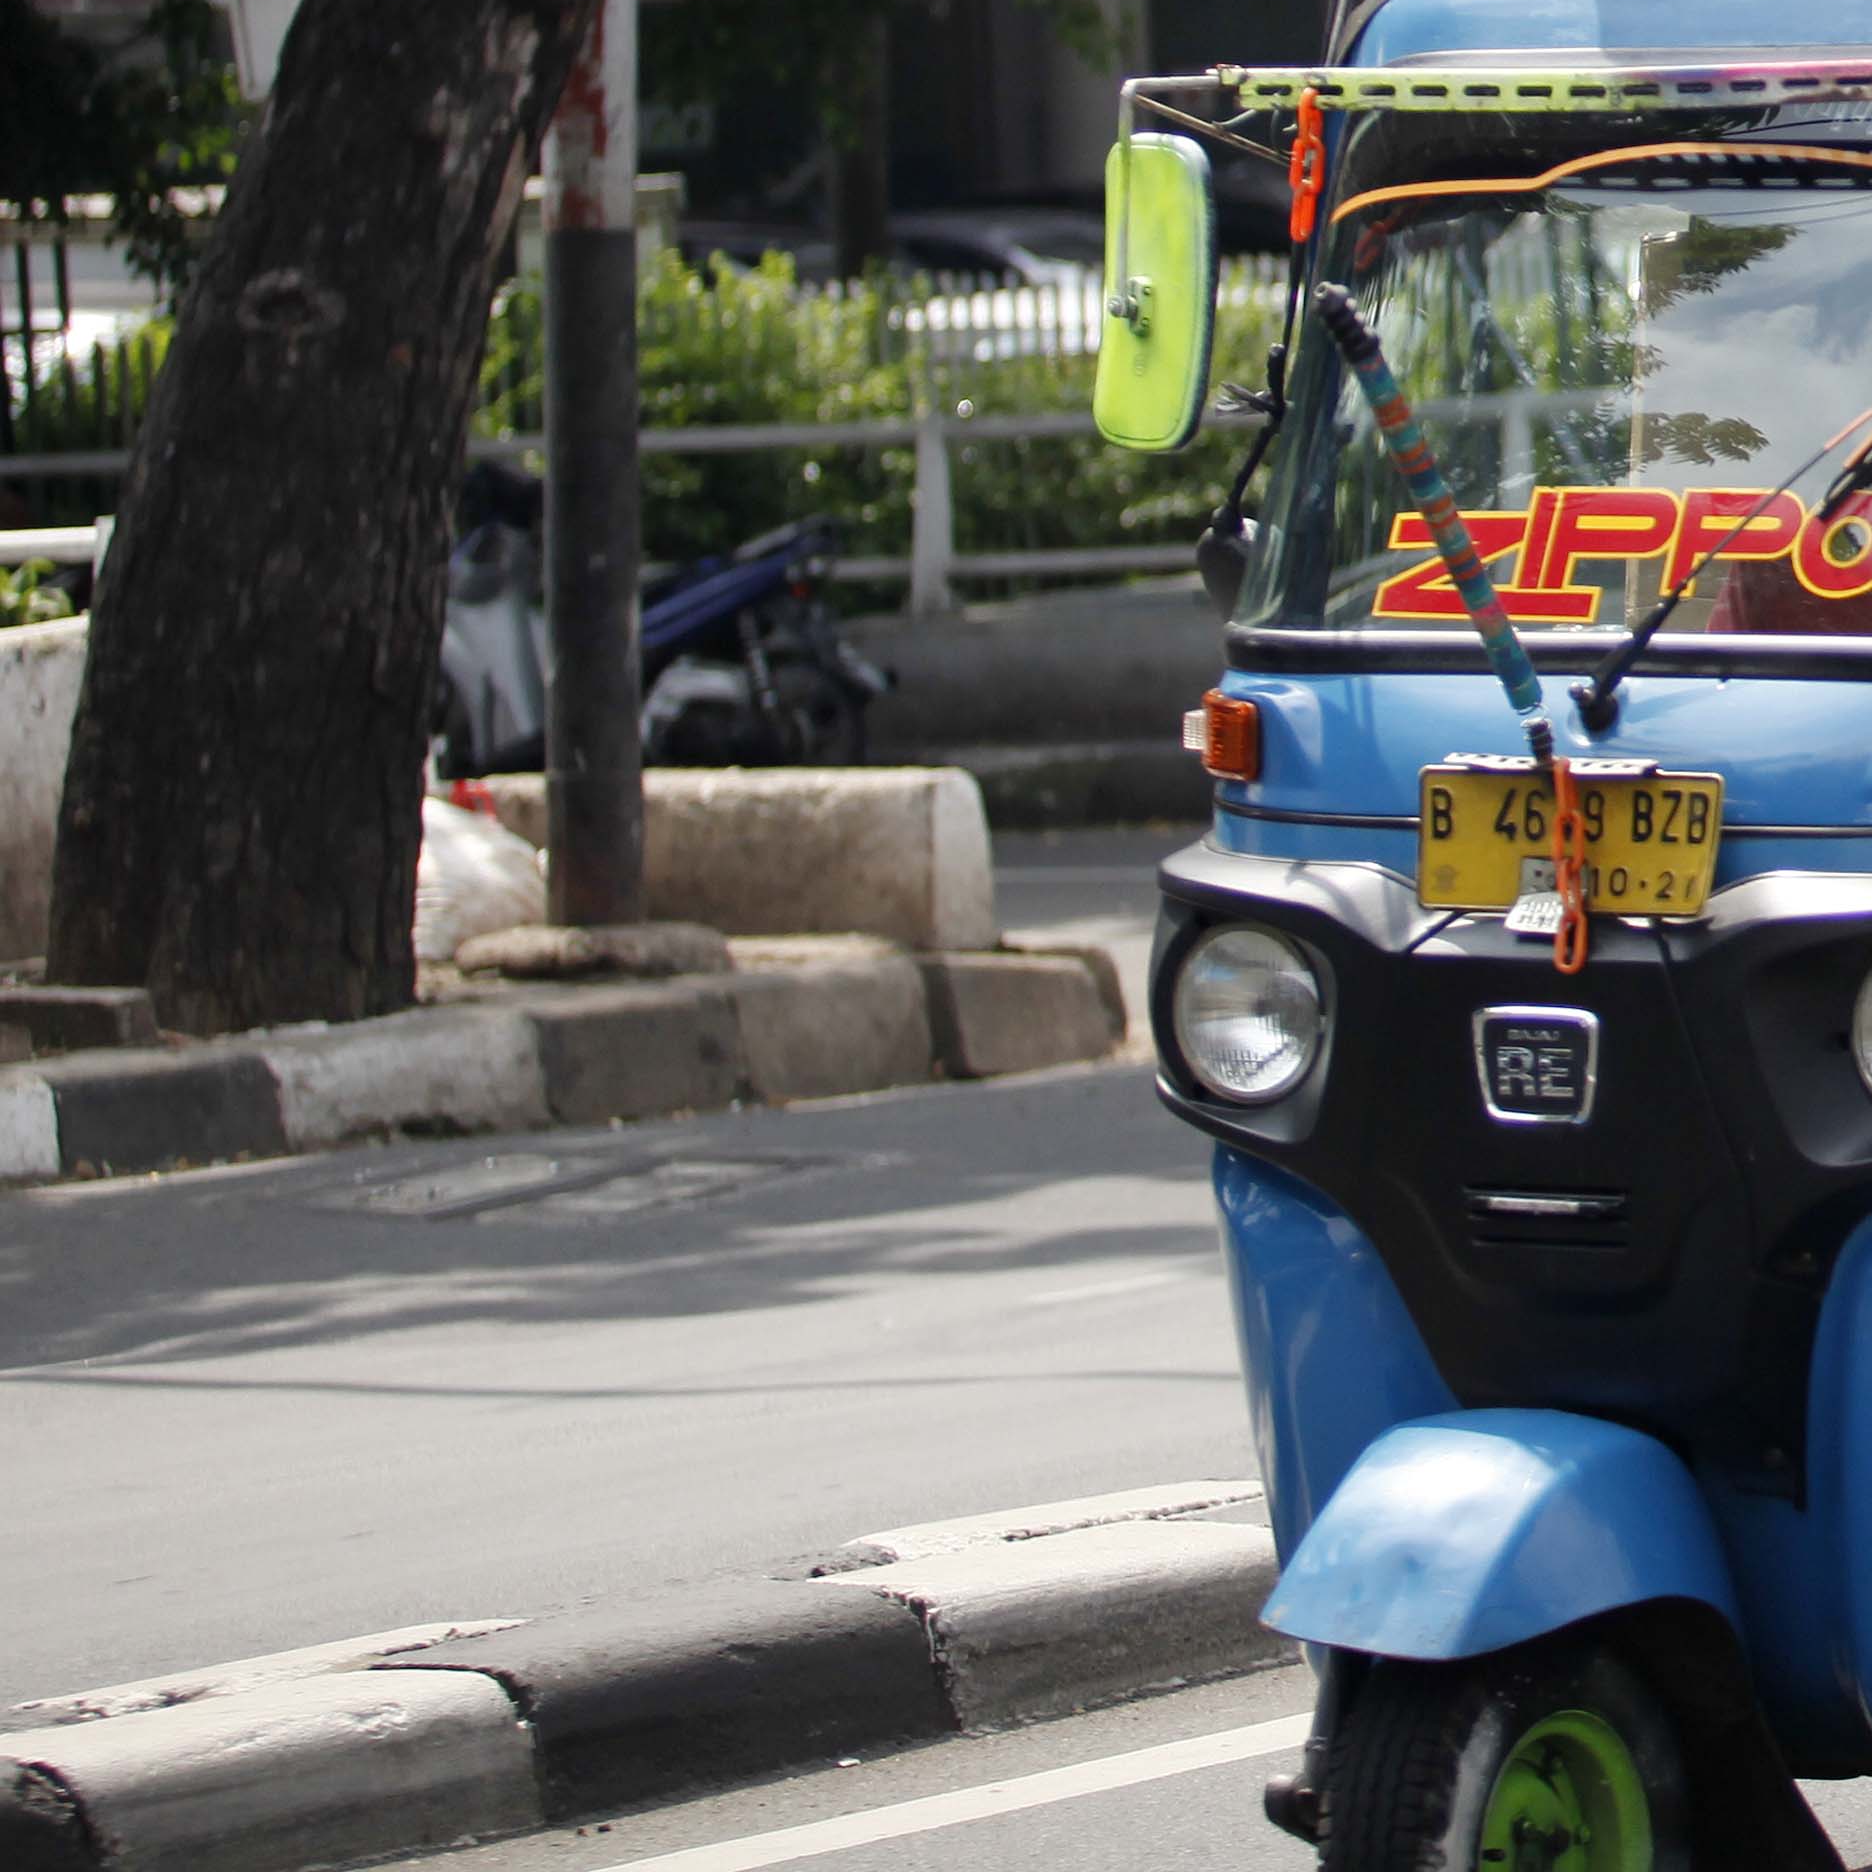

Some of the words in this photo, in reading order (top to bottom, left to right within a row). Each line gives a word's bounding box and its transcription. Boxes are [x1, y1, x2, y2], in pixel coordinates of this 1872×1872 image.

[1430, 786, 1454, 841] B
[1493, 787, 1605, 844] 469
[1631, 789, 1712, 845] BZB
[1496, 1045, 1576, 1098] RE
